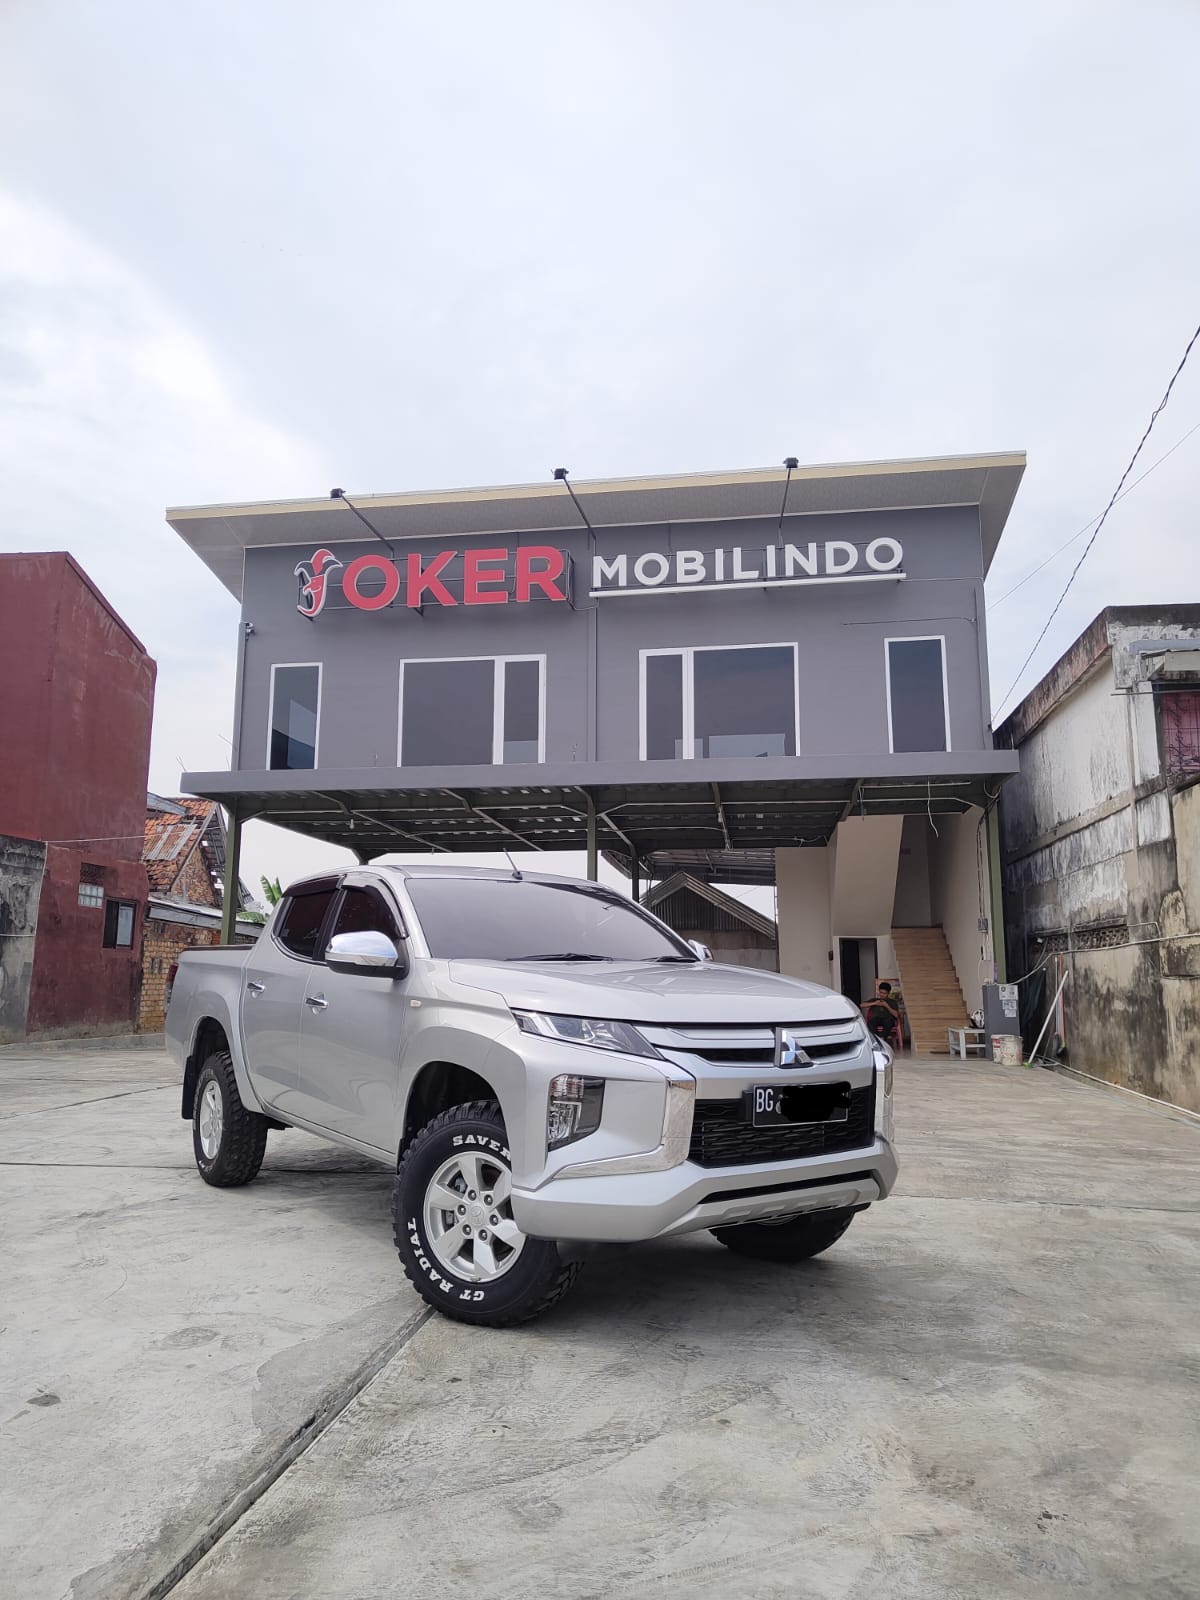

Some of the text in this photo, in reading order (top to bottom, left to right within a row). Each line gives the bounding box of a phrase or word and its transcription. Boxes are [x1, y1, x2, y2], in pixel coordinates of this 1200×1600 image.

[592, 537, 904, 588] MOBILINDO
[756, 1088, 774, 1112] BG
[407, 1217, 485, 1301] GT RADIAL
